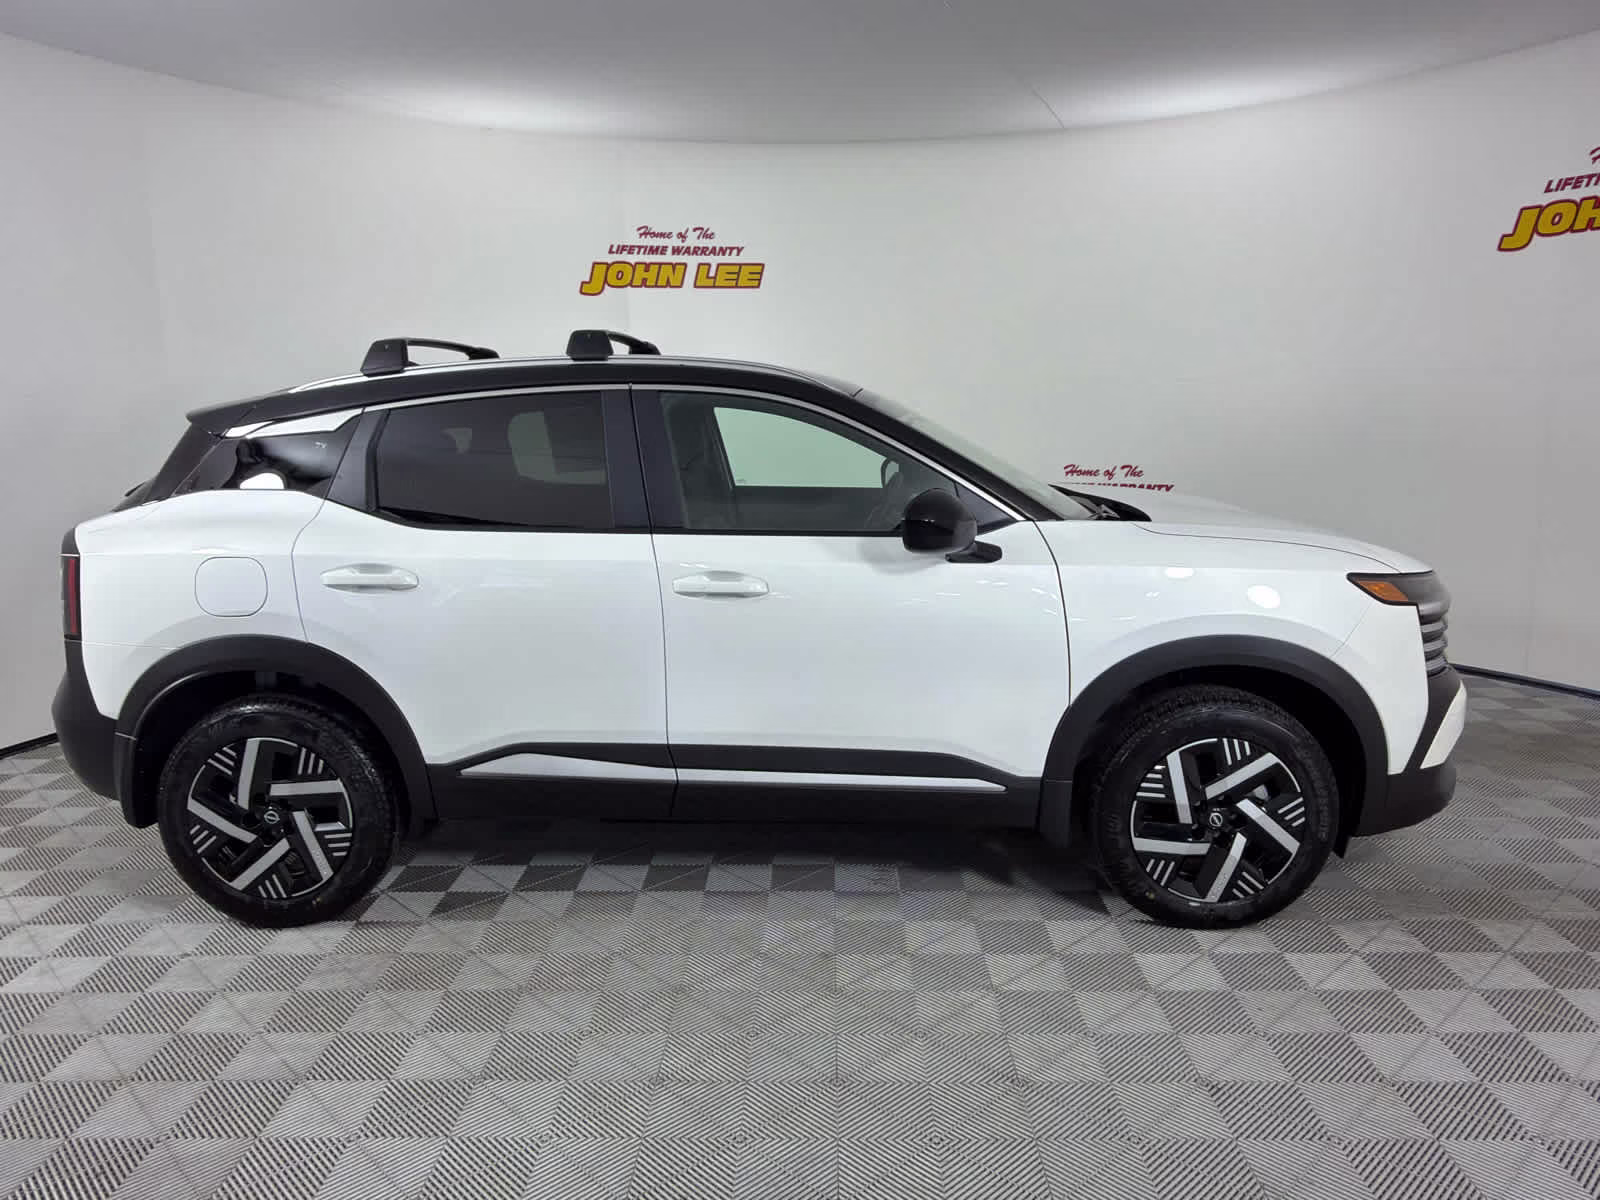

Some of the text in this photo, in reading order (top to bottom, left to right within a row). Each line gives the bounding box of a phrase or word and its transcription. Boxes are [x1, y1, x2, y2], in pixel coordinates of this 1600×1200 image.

[636, 225, 716, 243] Home of The
[607, 244, 745, 257] LIFETIME WARRANTY
[579, 261, 765, 296] JOHN LEE
[1063, 463, 1144, 481] Home of The
